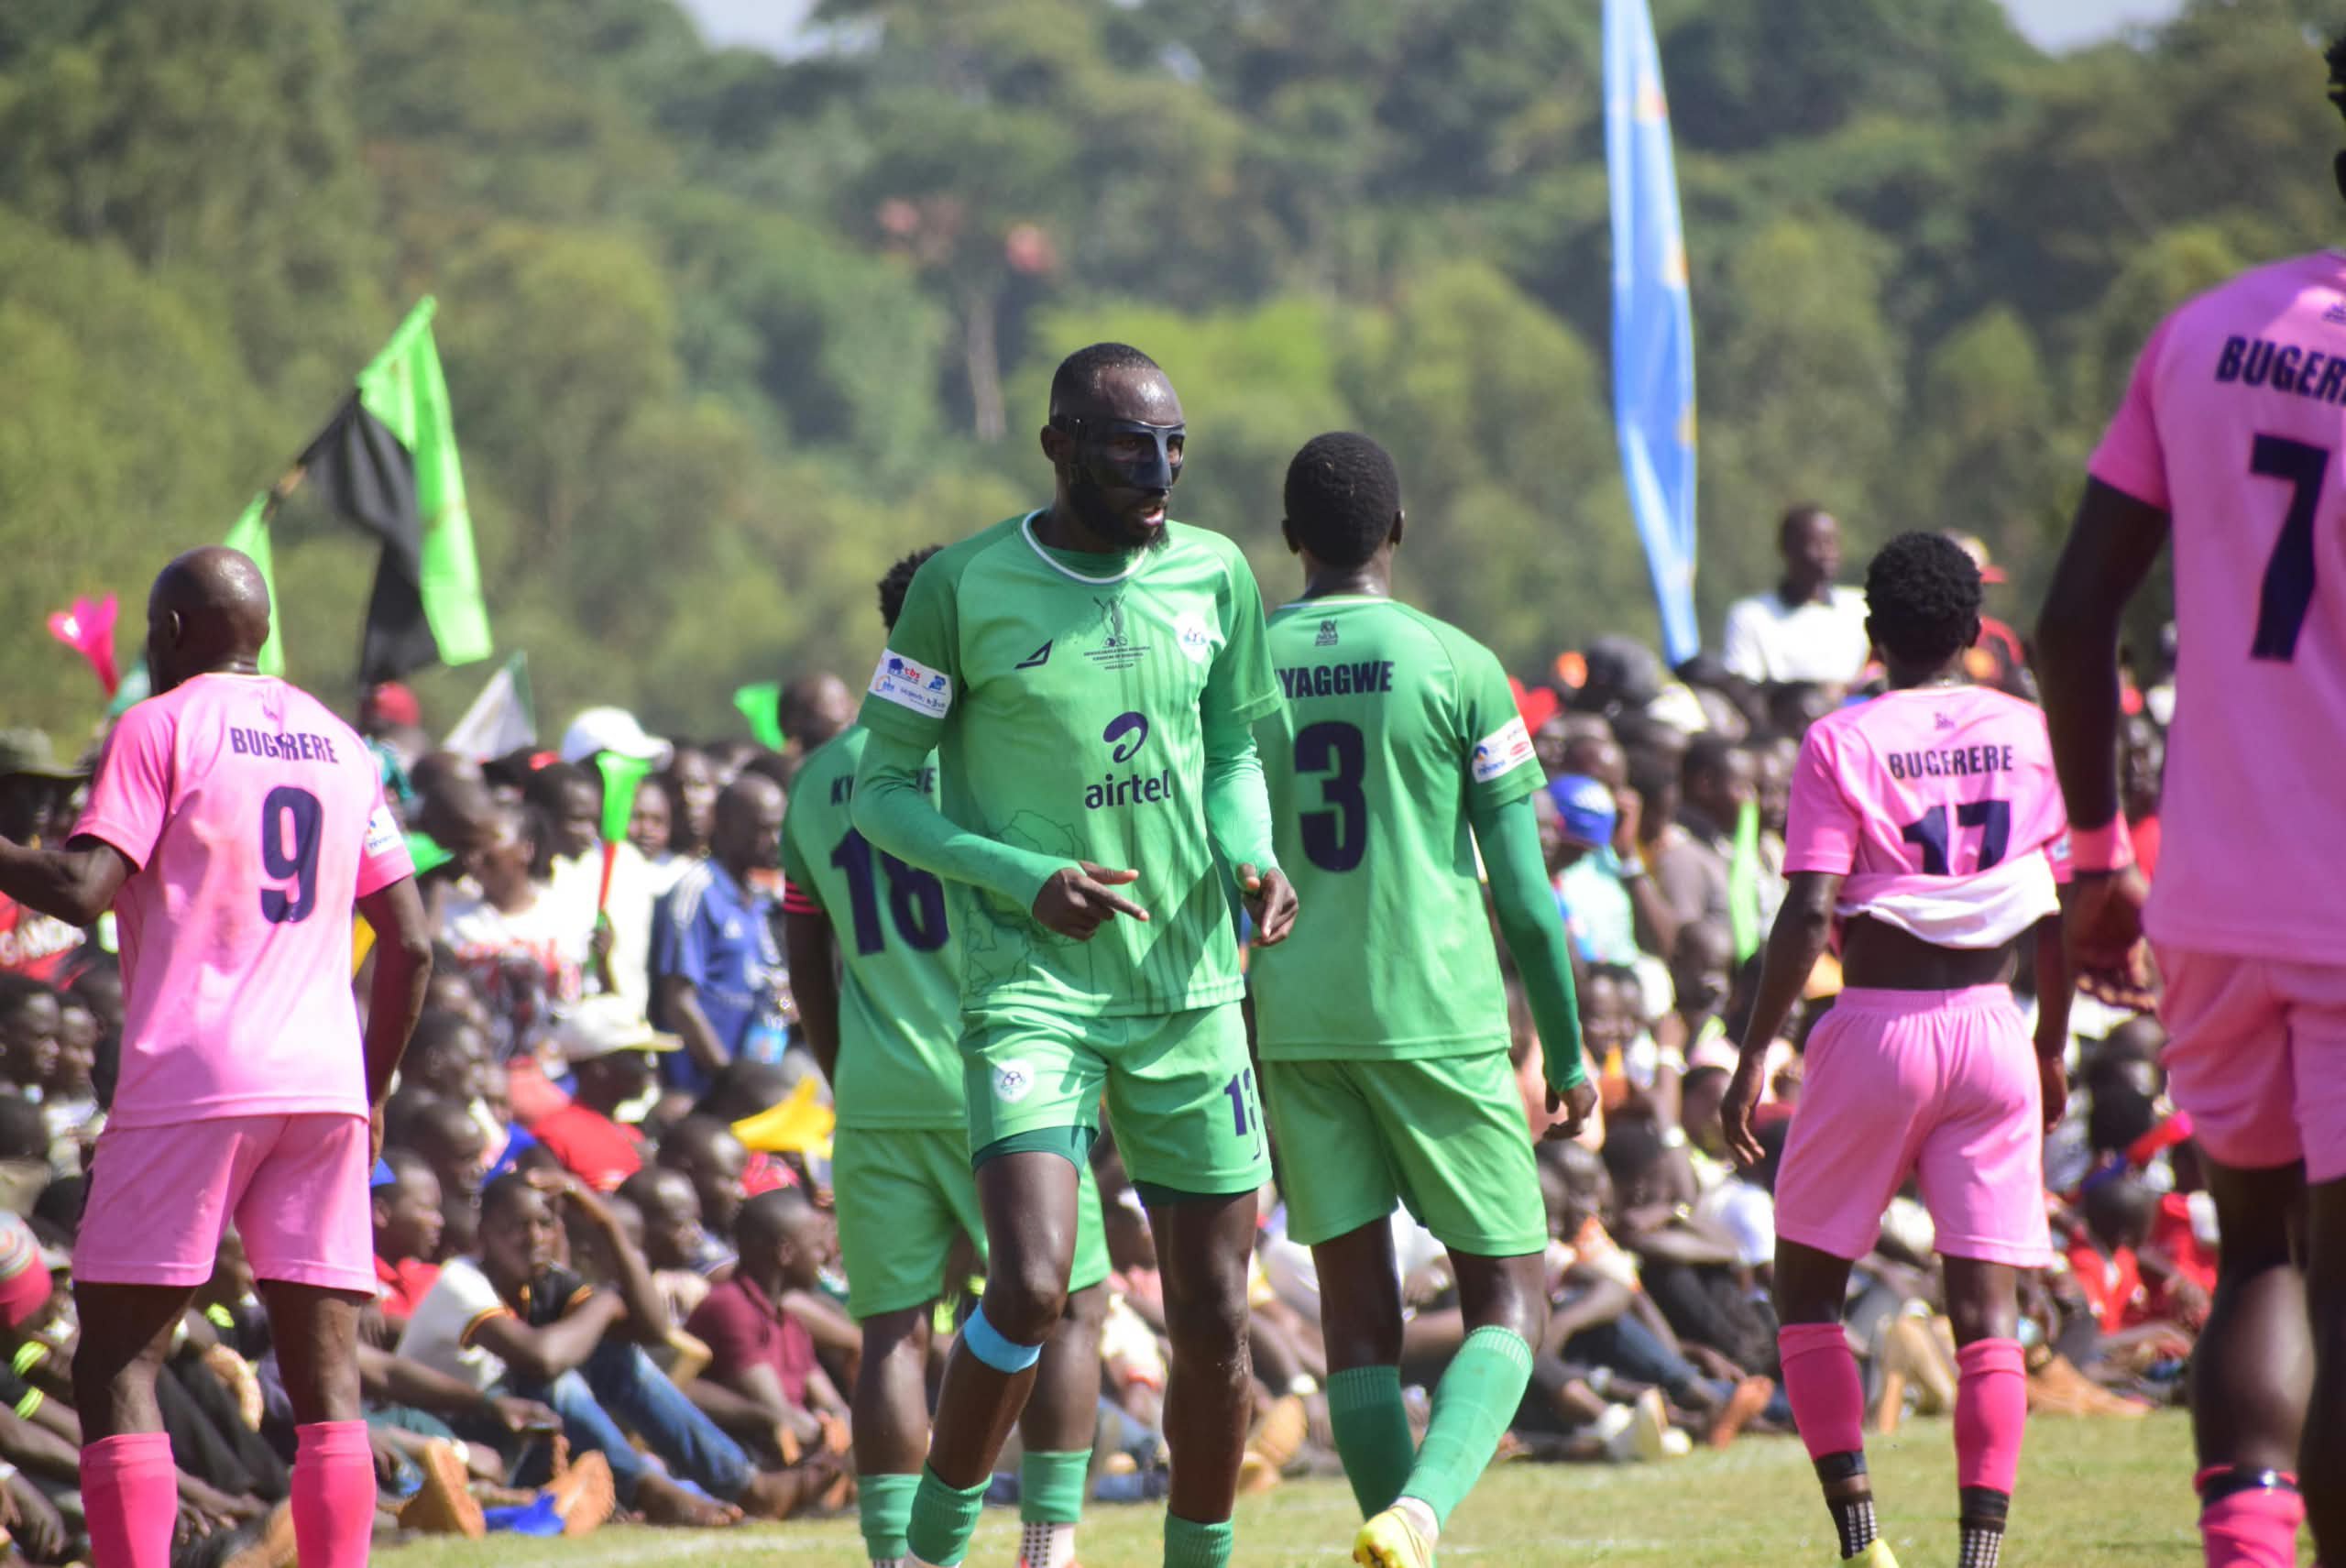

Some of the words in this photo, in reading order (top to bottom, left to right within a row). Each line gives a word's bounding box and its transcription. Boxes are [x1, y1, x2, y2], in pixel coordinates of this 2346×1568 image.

[2215, 334, 2346, 406] BUGER
[2250, 432, 2330, 663] 7
[1276, 661, 1395, 699] YAGGWE
[1084, 769, 1171, 809] airtel
[1295, 720, 1367, 873] 3
[1888, 744, 2013, 779] BUGERERE
[261, 786, 324, 925] 9
